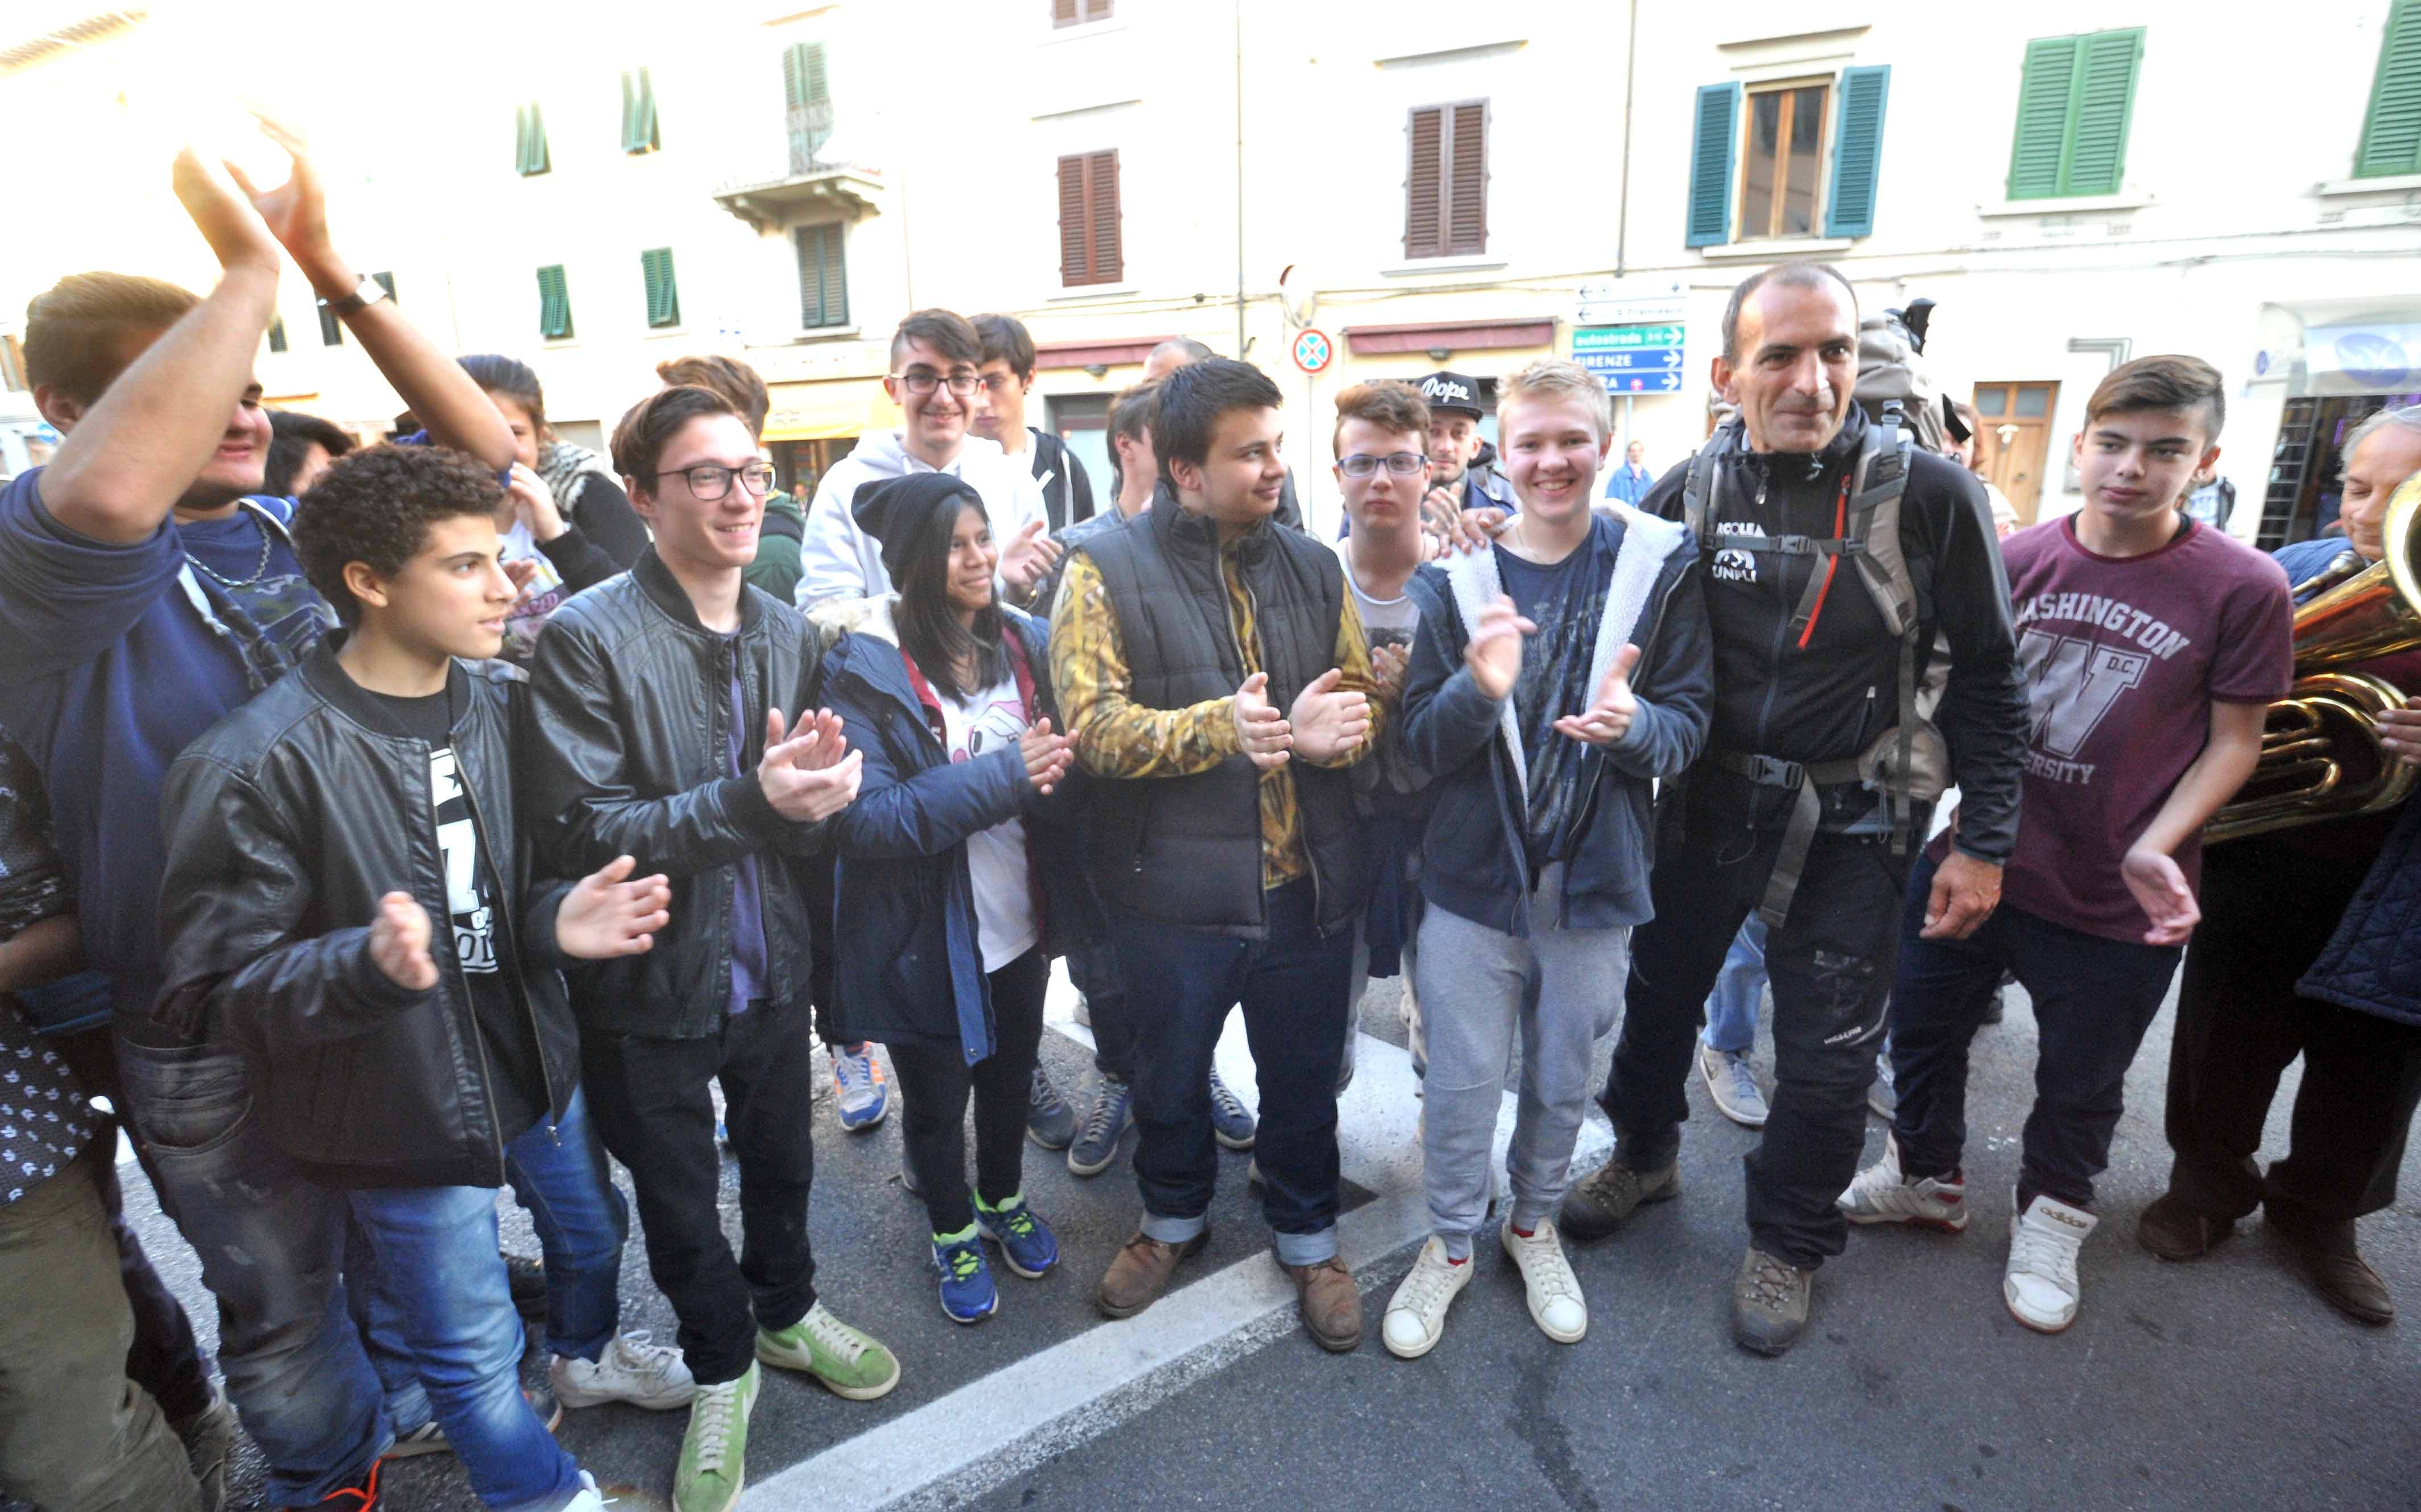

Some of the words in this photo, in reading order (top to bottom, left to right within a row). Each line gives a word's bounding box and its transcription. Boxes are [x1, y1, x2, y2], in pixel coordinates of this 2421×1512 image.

[1421, 377, 1470, 403] Dope
[2106, 656, 2134, 675] D.C.
[2039, 1206, 2088, 1229] adidas
